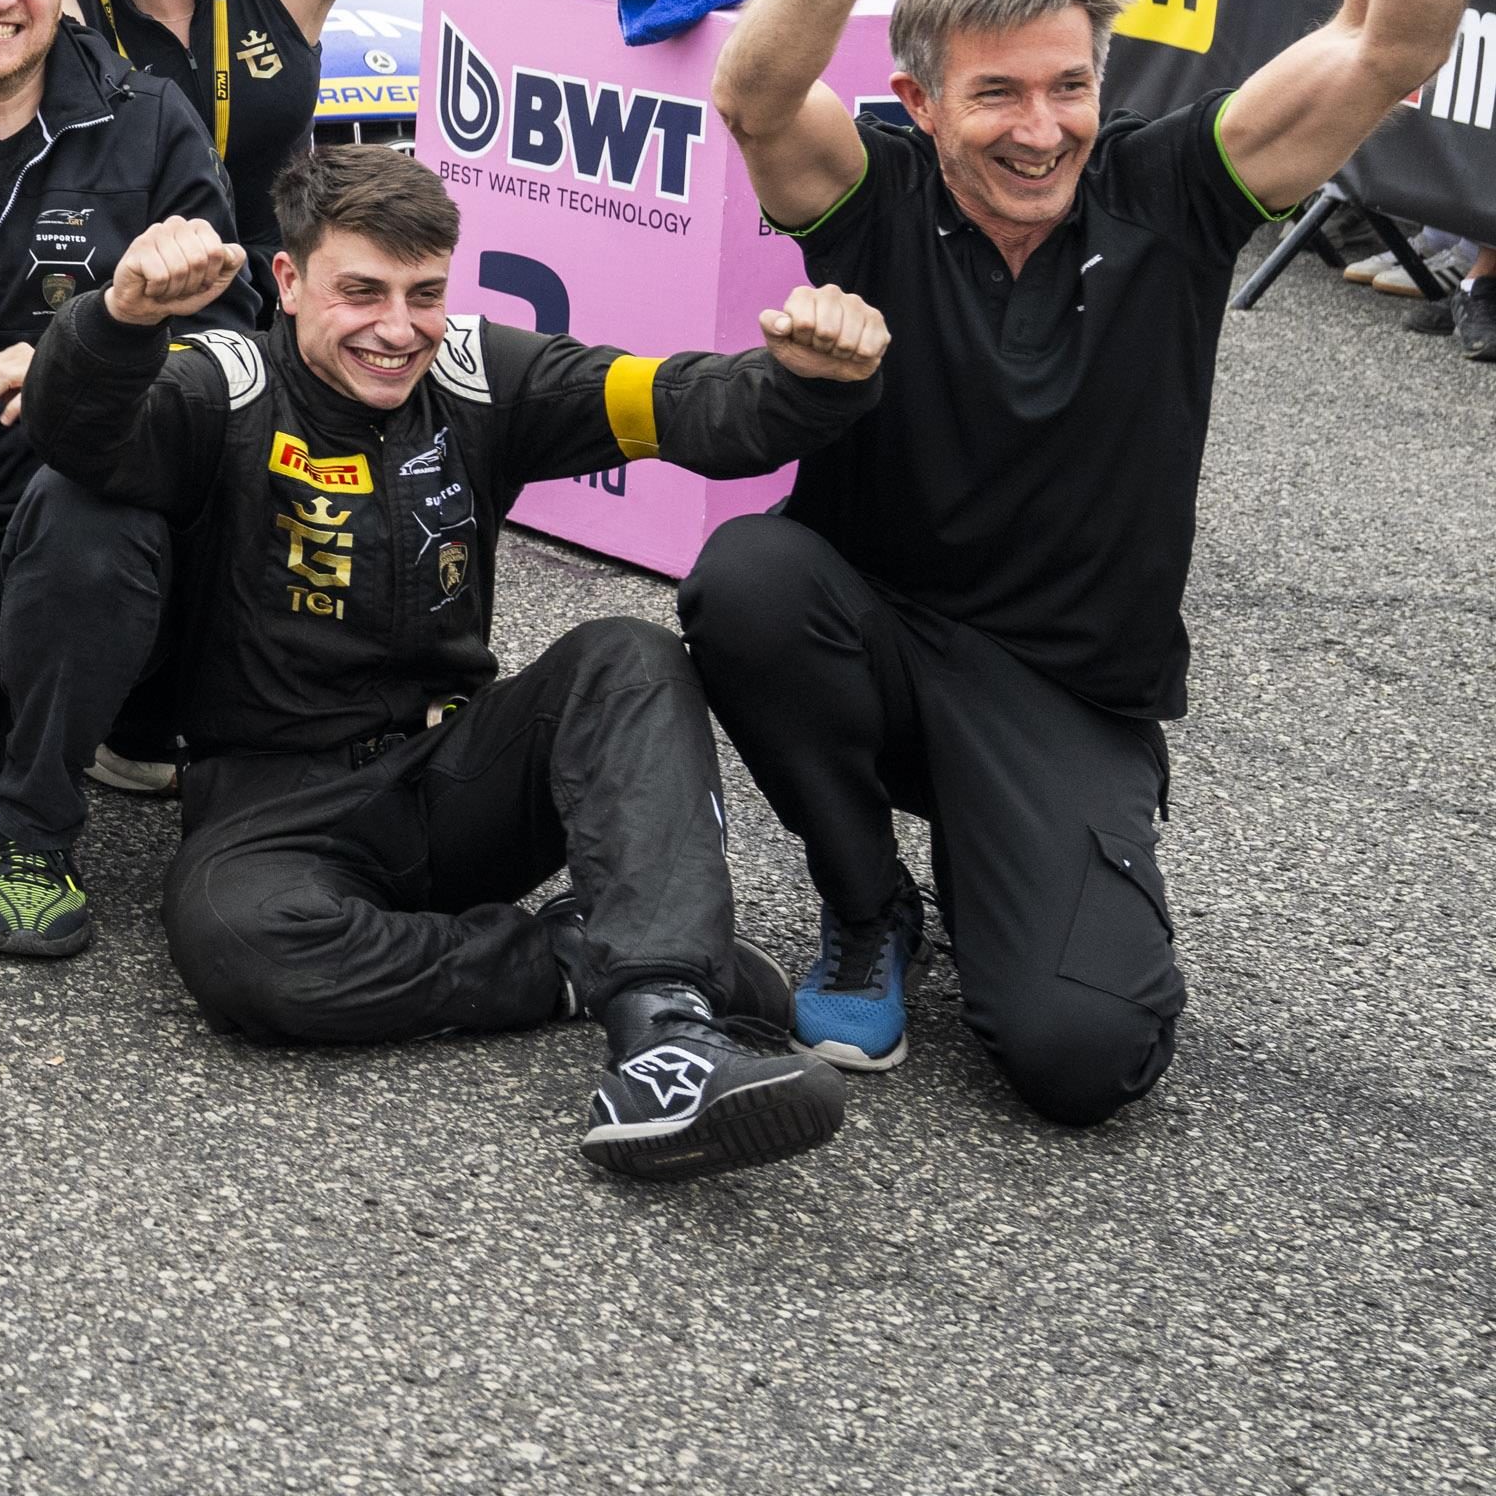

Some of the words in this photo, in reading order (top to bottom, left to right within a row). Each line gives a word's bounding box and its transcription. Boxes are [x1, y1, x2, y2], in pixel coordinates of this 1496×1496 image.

[217, 71, 228, 100] DTM
[511, 70, 704, 197] BWT
[439, 159, 484, 186] BEST
[488, 173, 551, 205] WATER
[556, 187, 693, 237] TECHNOLOGY
[35, 234, 87, 243] SUPPORTED
[55, 243, 68, 251] BY
[279, 443, 360, 486] PIRELLI
[285, 585, 345, 621] TGI
